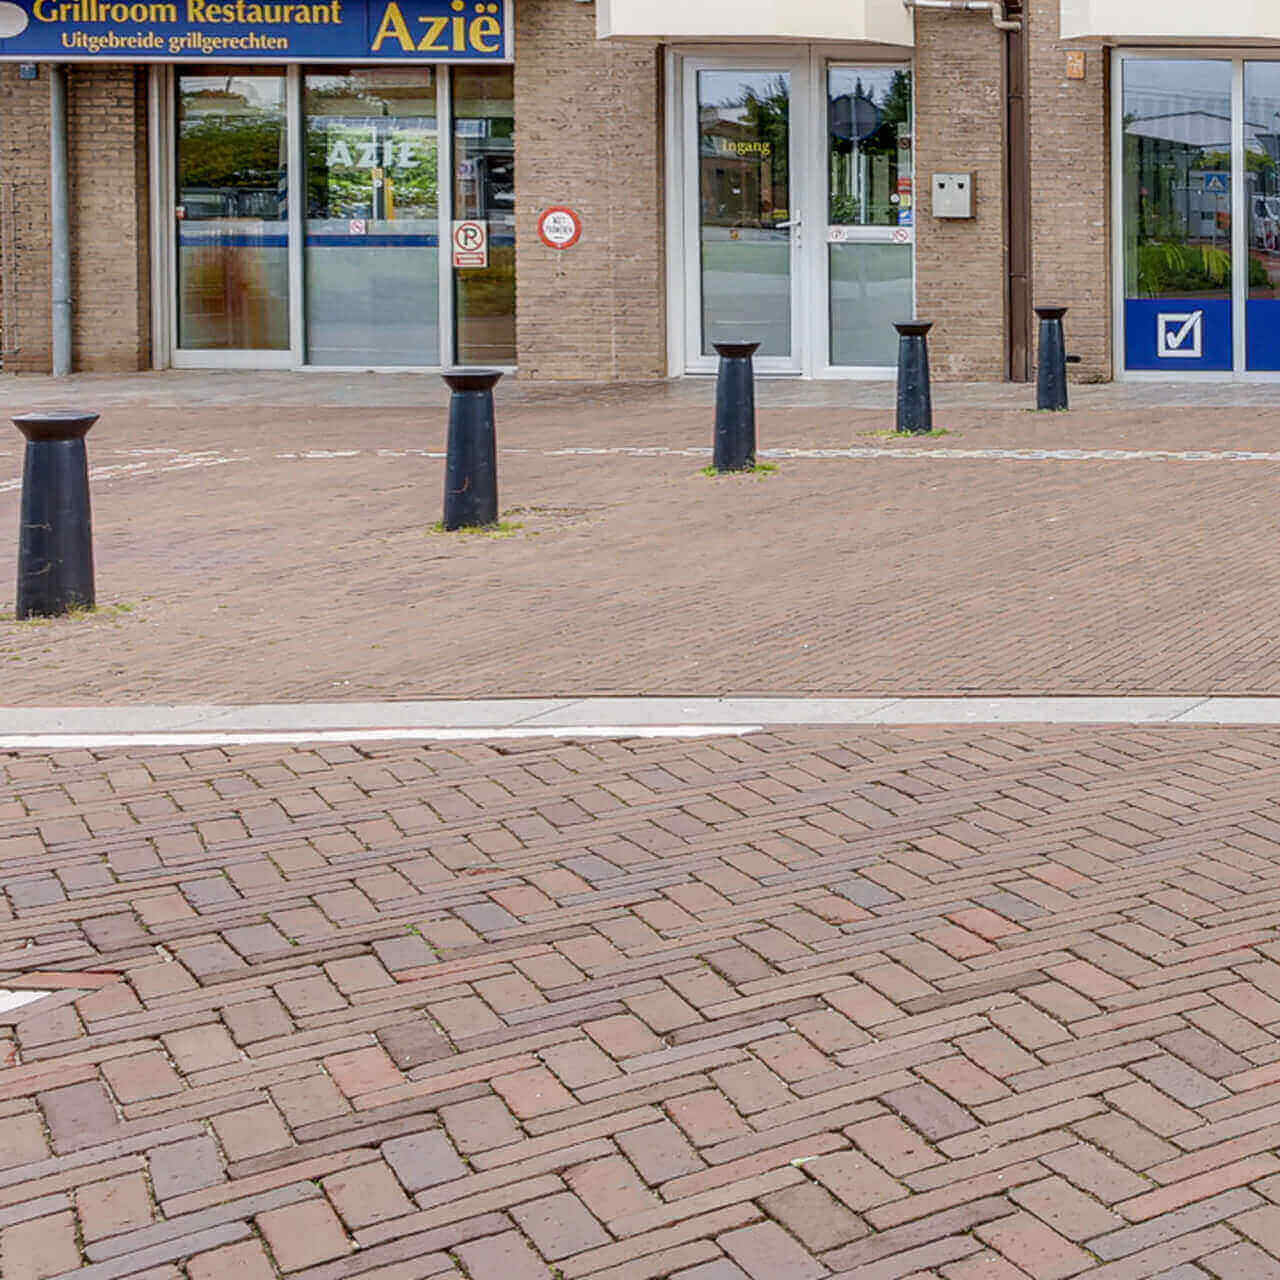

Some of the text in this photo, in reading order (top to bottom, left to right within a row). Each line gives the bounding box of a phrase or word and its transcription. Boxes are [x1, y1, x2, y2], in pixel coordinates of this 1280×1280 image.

[61, 30, 289, 54] Uitgebreide grillgerechten
[371, 0, 501, 53] Azië
